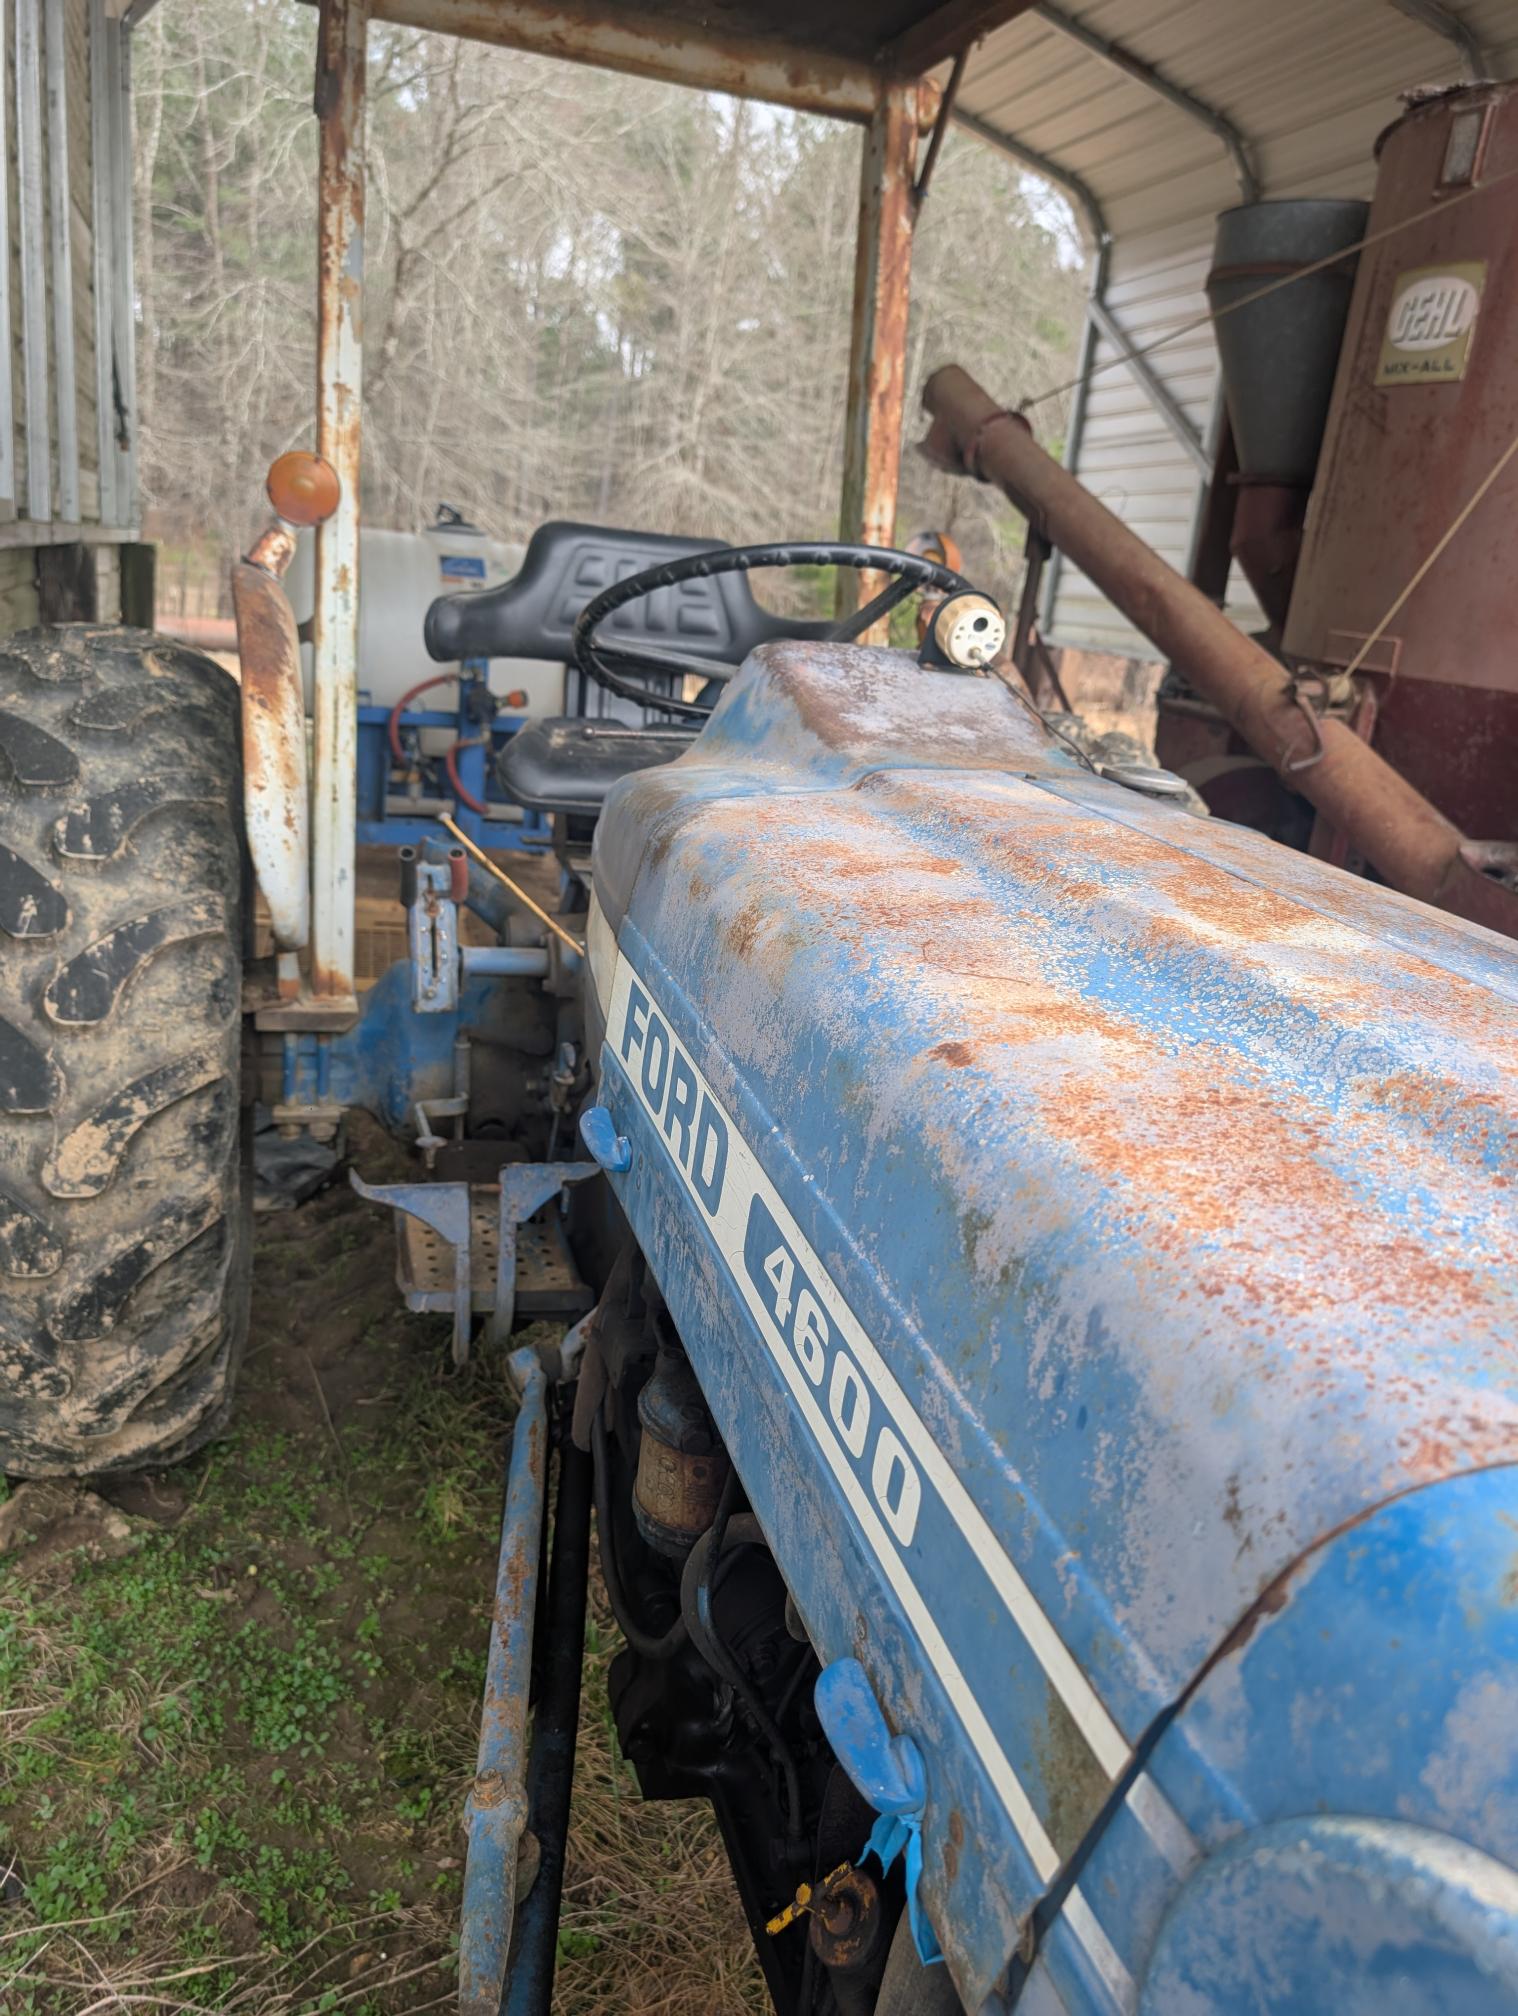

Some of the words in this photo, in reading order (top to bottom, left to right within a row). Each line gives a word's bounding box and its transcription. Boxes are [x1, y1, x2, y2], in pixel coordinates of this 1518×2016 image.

[1384, 359, 1455, 375] MIX-ALL
[1391, 288, 1469, 345] GEHL
[621, 978, 729, 1218] FORD
[764, 1245, 922, 1547] 4600
